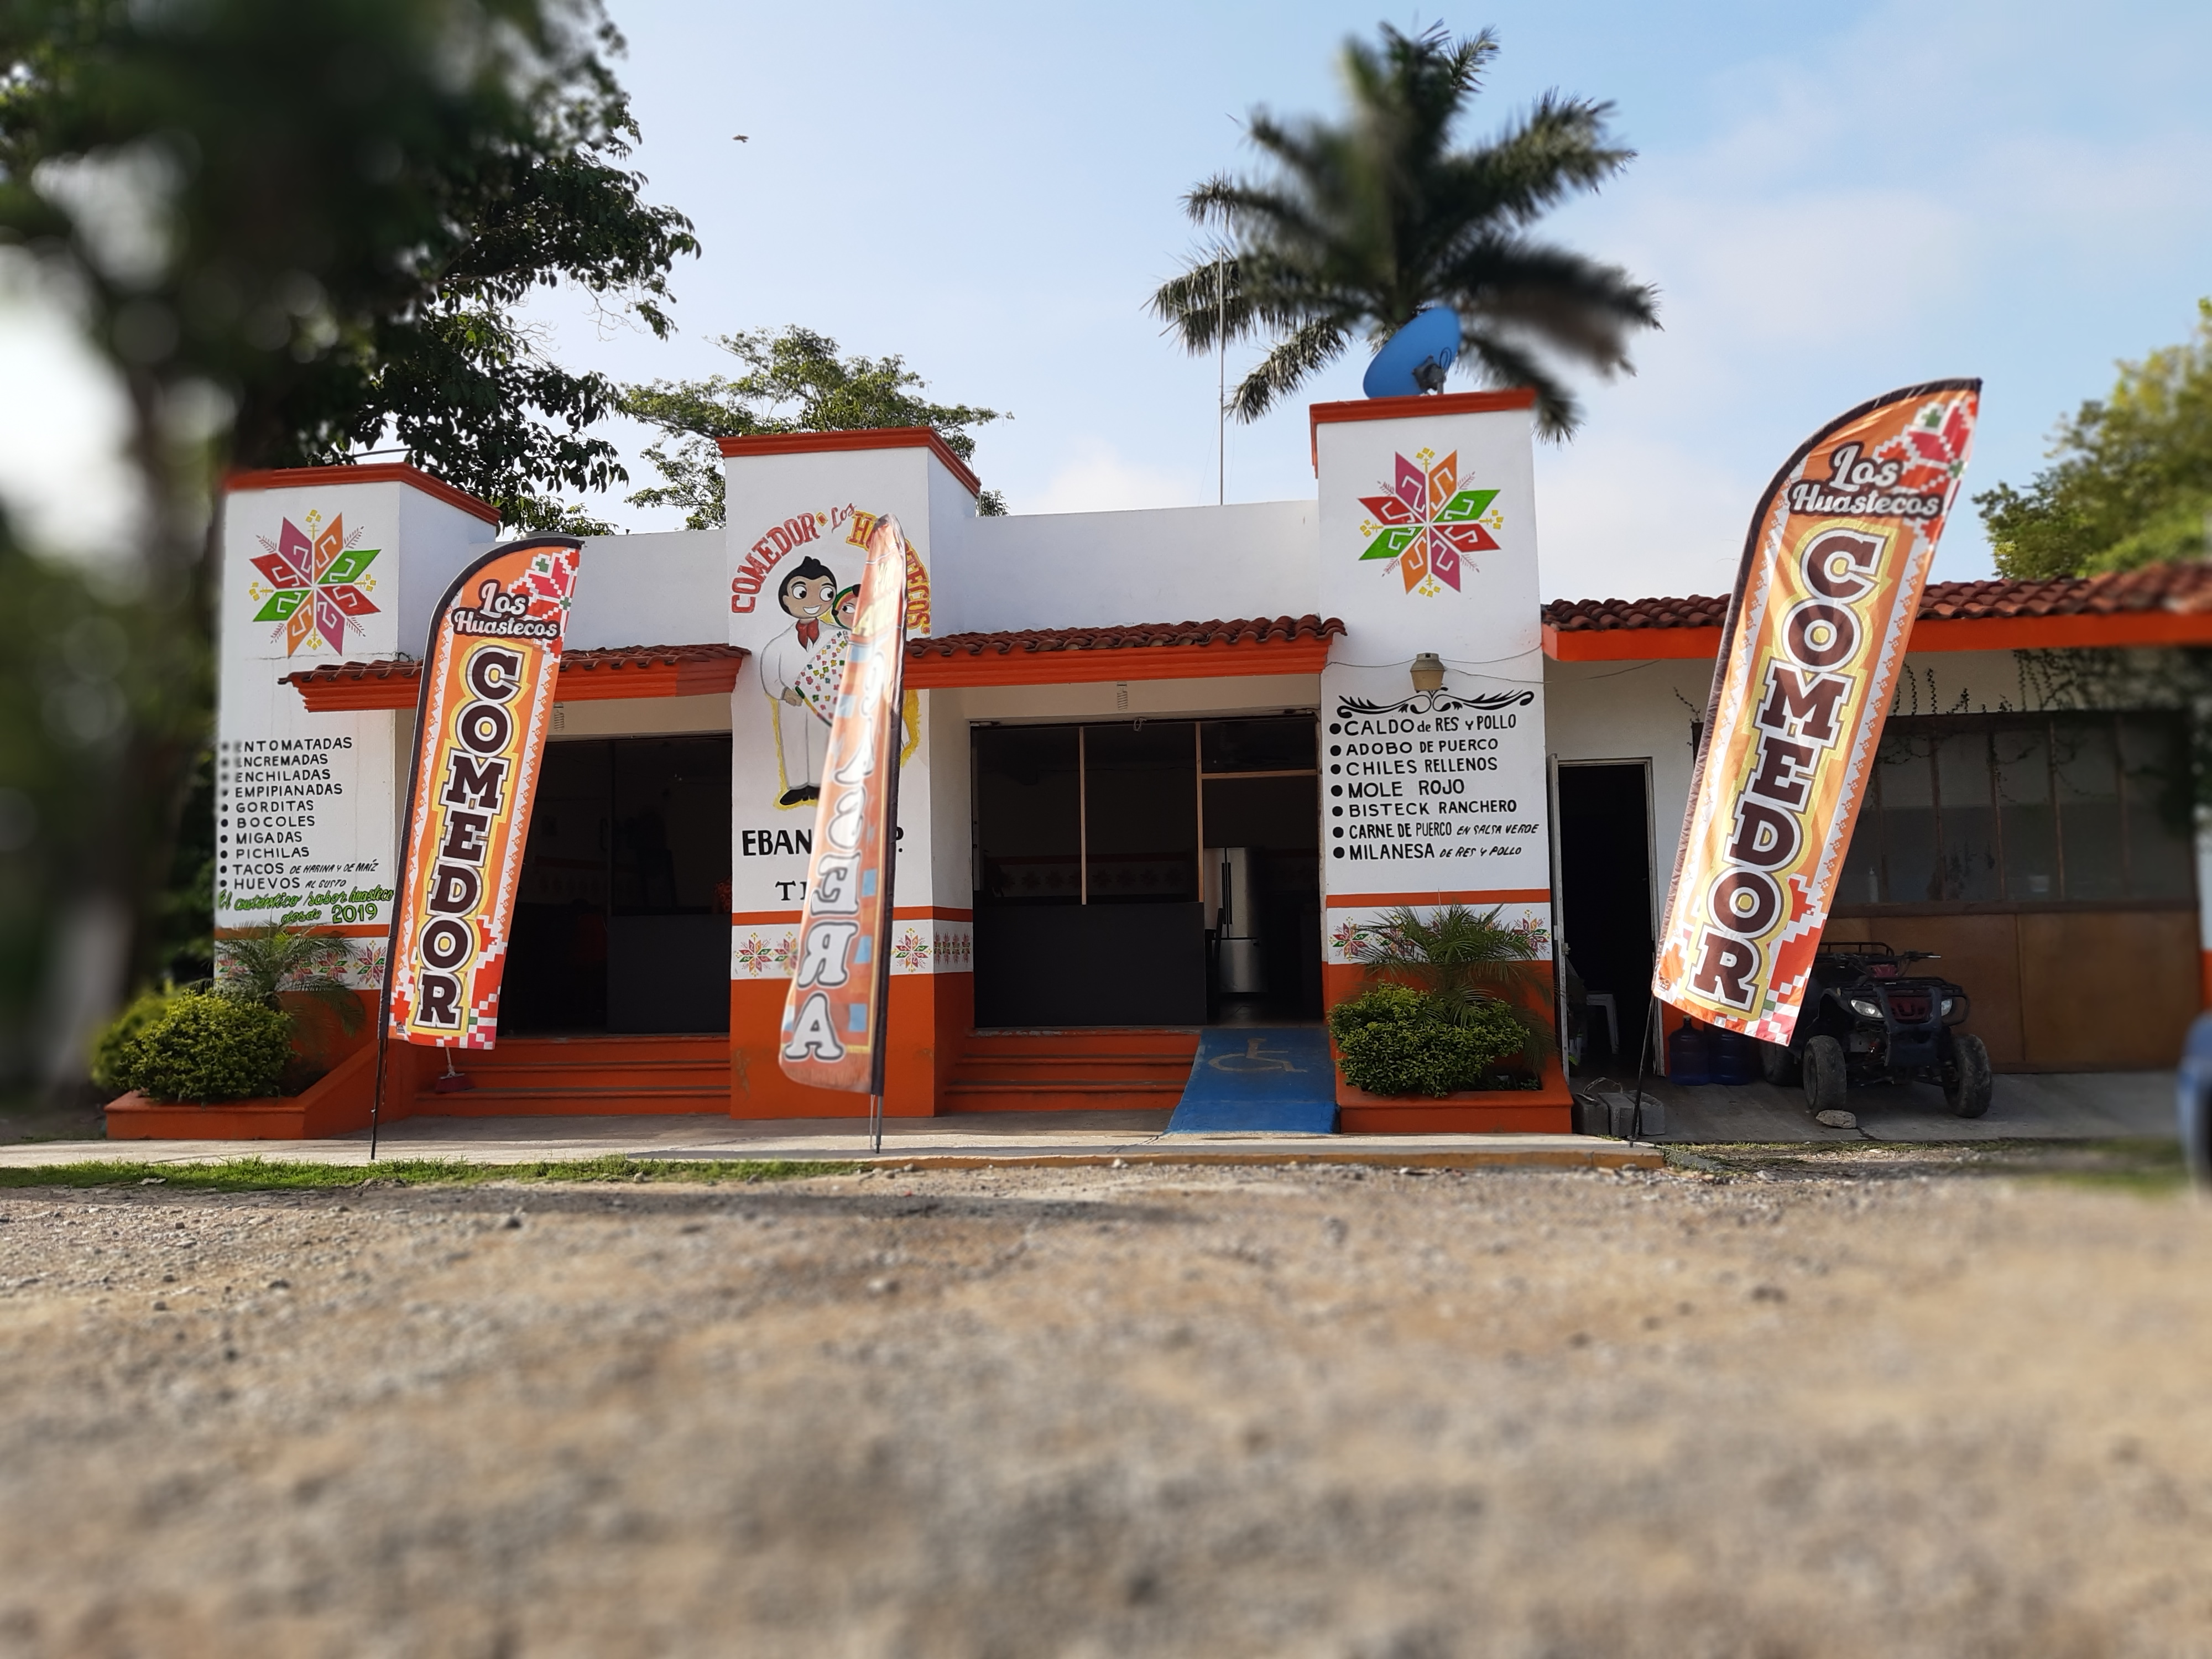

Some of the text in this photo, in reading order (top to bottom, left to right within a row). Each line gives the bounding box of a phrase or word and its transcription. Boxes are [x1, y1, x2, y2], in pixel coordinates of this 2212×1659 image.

[1829, 444, 1899, 492] Los
[1792, 483, 1939, 515] Huastecos
[731, 513, 821, 613] COMEDOR
[831, 503, 857, 533] Los
[479, 582, 526, 619] Los
[454, 610, 558, 637] Huastecos
[1344, 718, 1415, 735] CALDO
[1417, 720, 1431, 733] de
[1435, 717, 1459, 732] RES
[1477, 714, 1516, 731] POLLO
[1346, 738, 1499, 756] ADOBO DE PUERCO
[1346, 757, 1498, 775] CHILES RELLENOS
[1688, 528, 1886, 1012] COMEDOR
[234, 769, 331, 782] ENCHILADAS
[235, 784, 343, 798] EMPIPIANADAS
[1348, 779, 1465, 798] MOLE ROJO
[236, 800, 314, 813] GORDITAS
[1349, 799, 1517, 817] BISTECK RANCHERO
[237, 816, 315, 828] BOCOLES
[1349, 822, 1540, 839] CARNE DE PUERCO EN SALSA VERDE
[236, 831, 302, 844] MIGADAS
[418, 646, 525, 1030] COMEDOR
[742, 828, 812, 857] EBAN
[236, 847, 310, 859] PICHILAS
[1349, 843, 1435, 860] MILANESA
[1439, 848, 1453, 858] DE
[1455, 847, 1477, 857] RES
[1489, 846, 1522, 857] POLLO
[232, 863, 284, 875] TACOS
[289, 865, 301, 874] DE
[303, 864, 333, 874] HARINA
[343, 863, 356, 873] DE
[234, 877, 347, 889] HUEVOS AL GUSTO
[348, 884, 394, 904] huasteco
[280, 903, 378, 924] desde 2019
